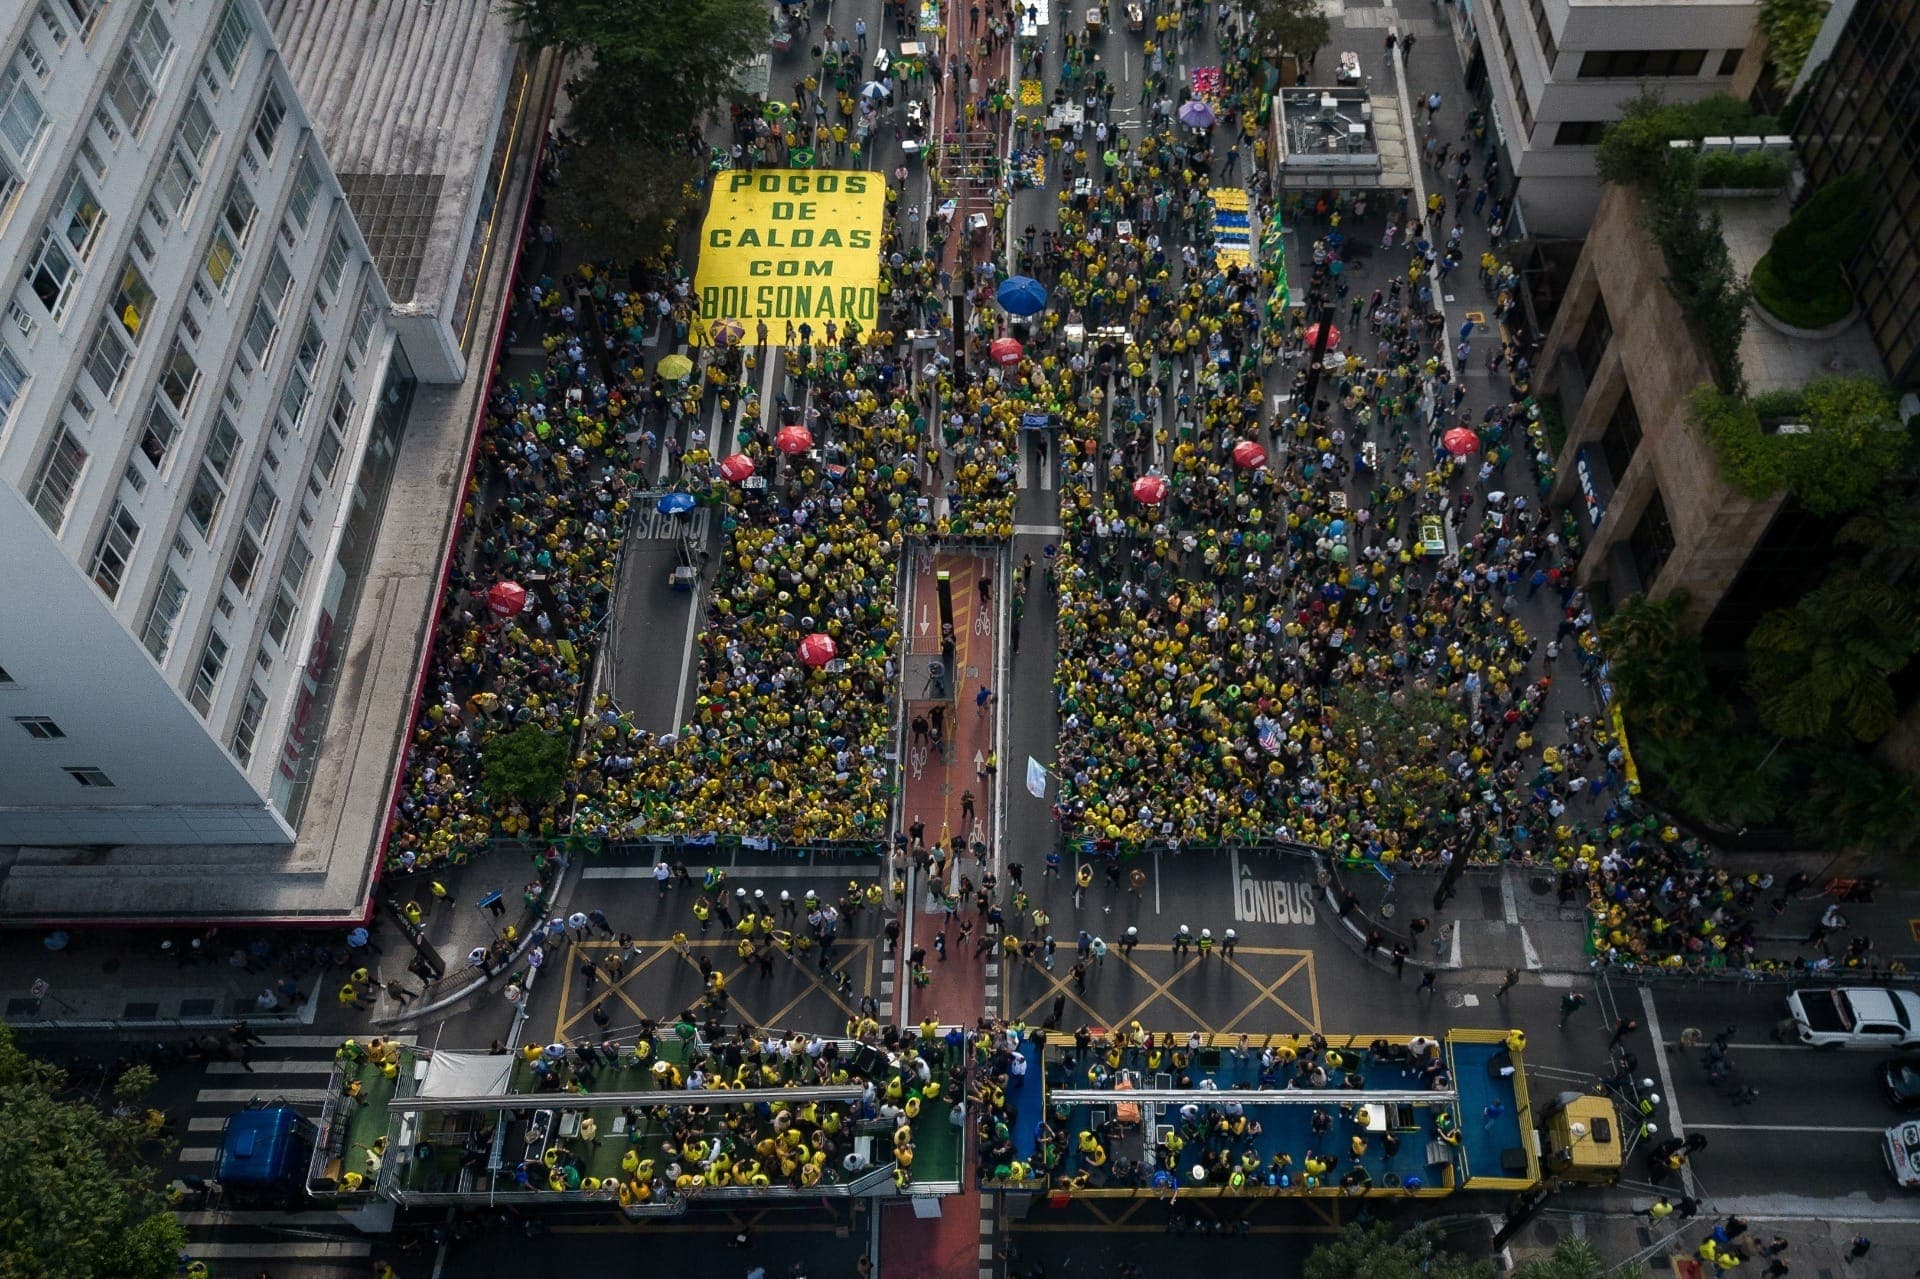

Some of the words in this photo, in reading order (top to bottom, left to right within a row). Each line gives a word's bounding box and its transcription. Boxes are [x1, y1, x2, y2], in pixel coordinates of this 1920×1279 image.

[730, 174, 867, 195] POÇOS
[771, 201, 817, 220] DE
[709, 228, 872, 249] CALDAS
[749, 260, 834, 277] COM
[701, 285, 875, 320] BOLSONARO
[1240, 863, 1316, 926] ÔNIBUS
